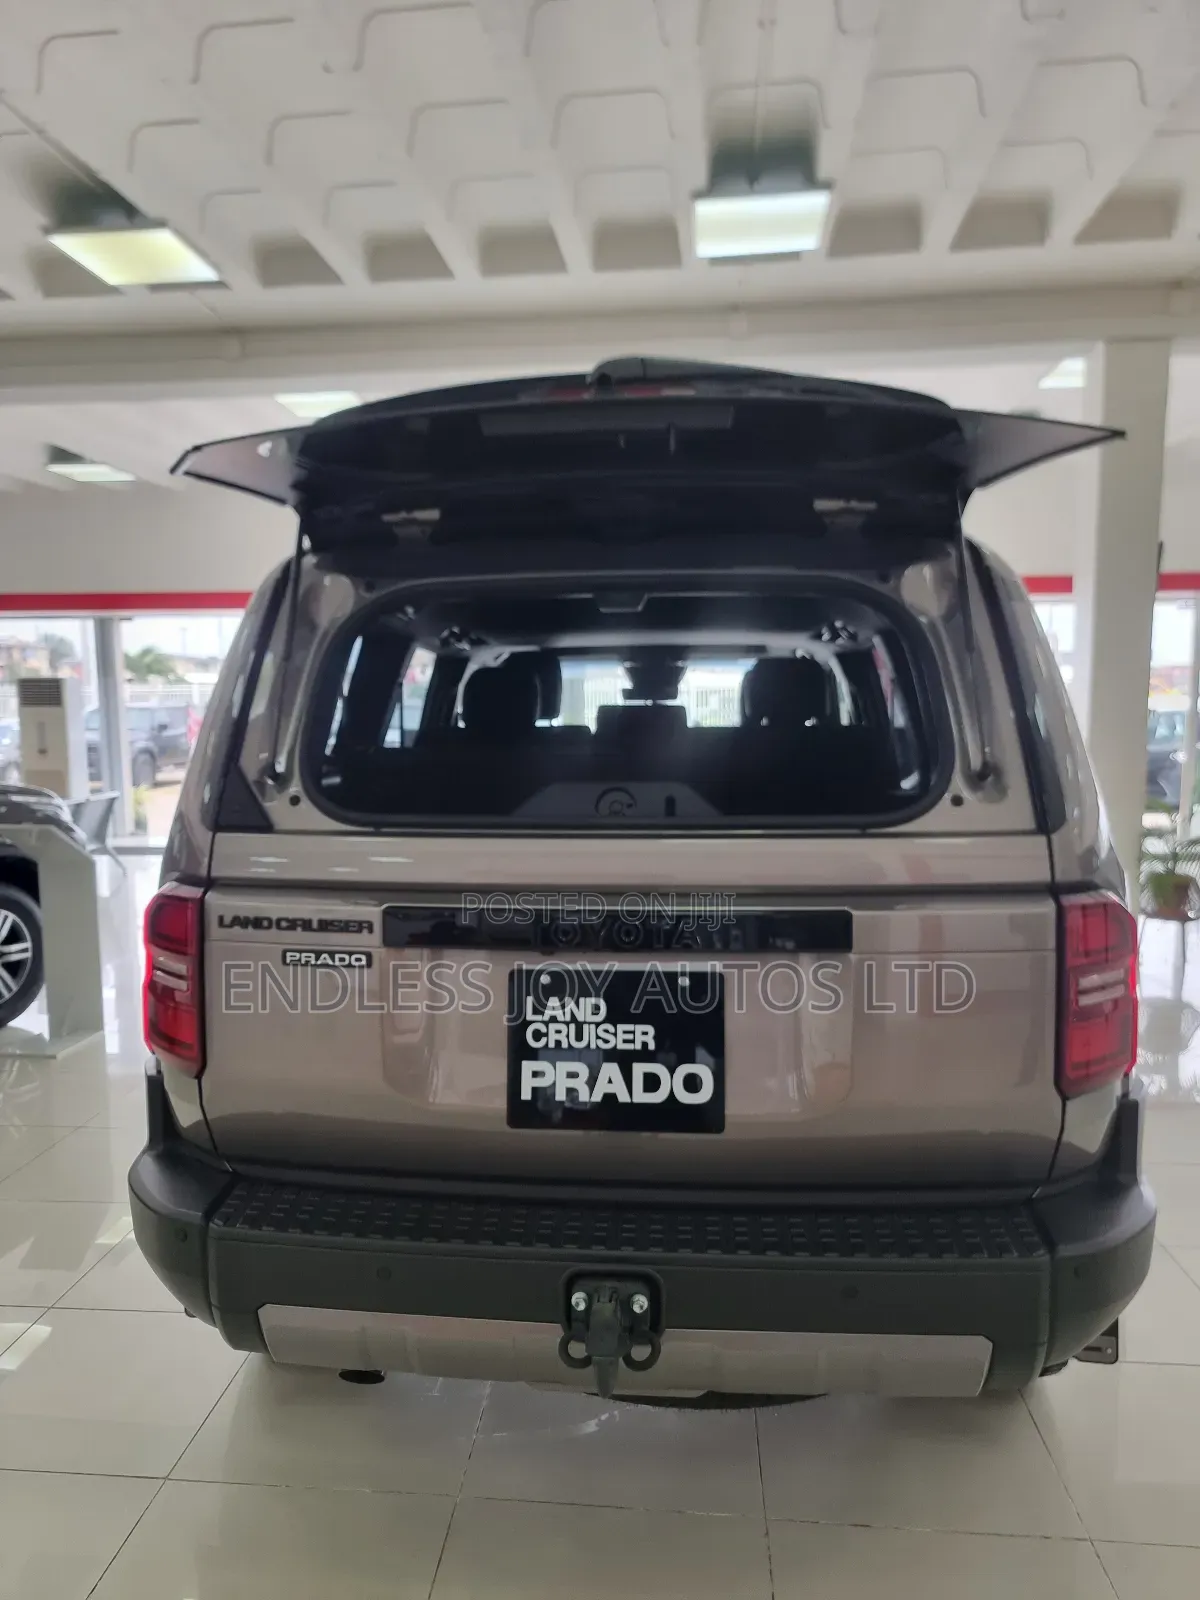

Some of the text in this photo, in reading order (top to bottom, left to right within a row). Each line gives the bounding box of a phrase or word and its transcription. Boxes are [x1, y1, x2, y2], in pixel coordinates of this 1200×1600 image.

[218, 915, 373, 934] LAND CRUISER
[285, 951, 367, 966] PRADO
[525, 996, 607, 1022] LAND
[525, 1023, 656, 1051] CRUISER
[520, 1060, 715, 1105] PRADO
